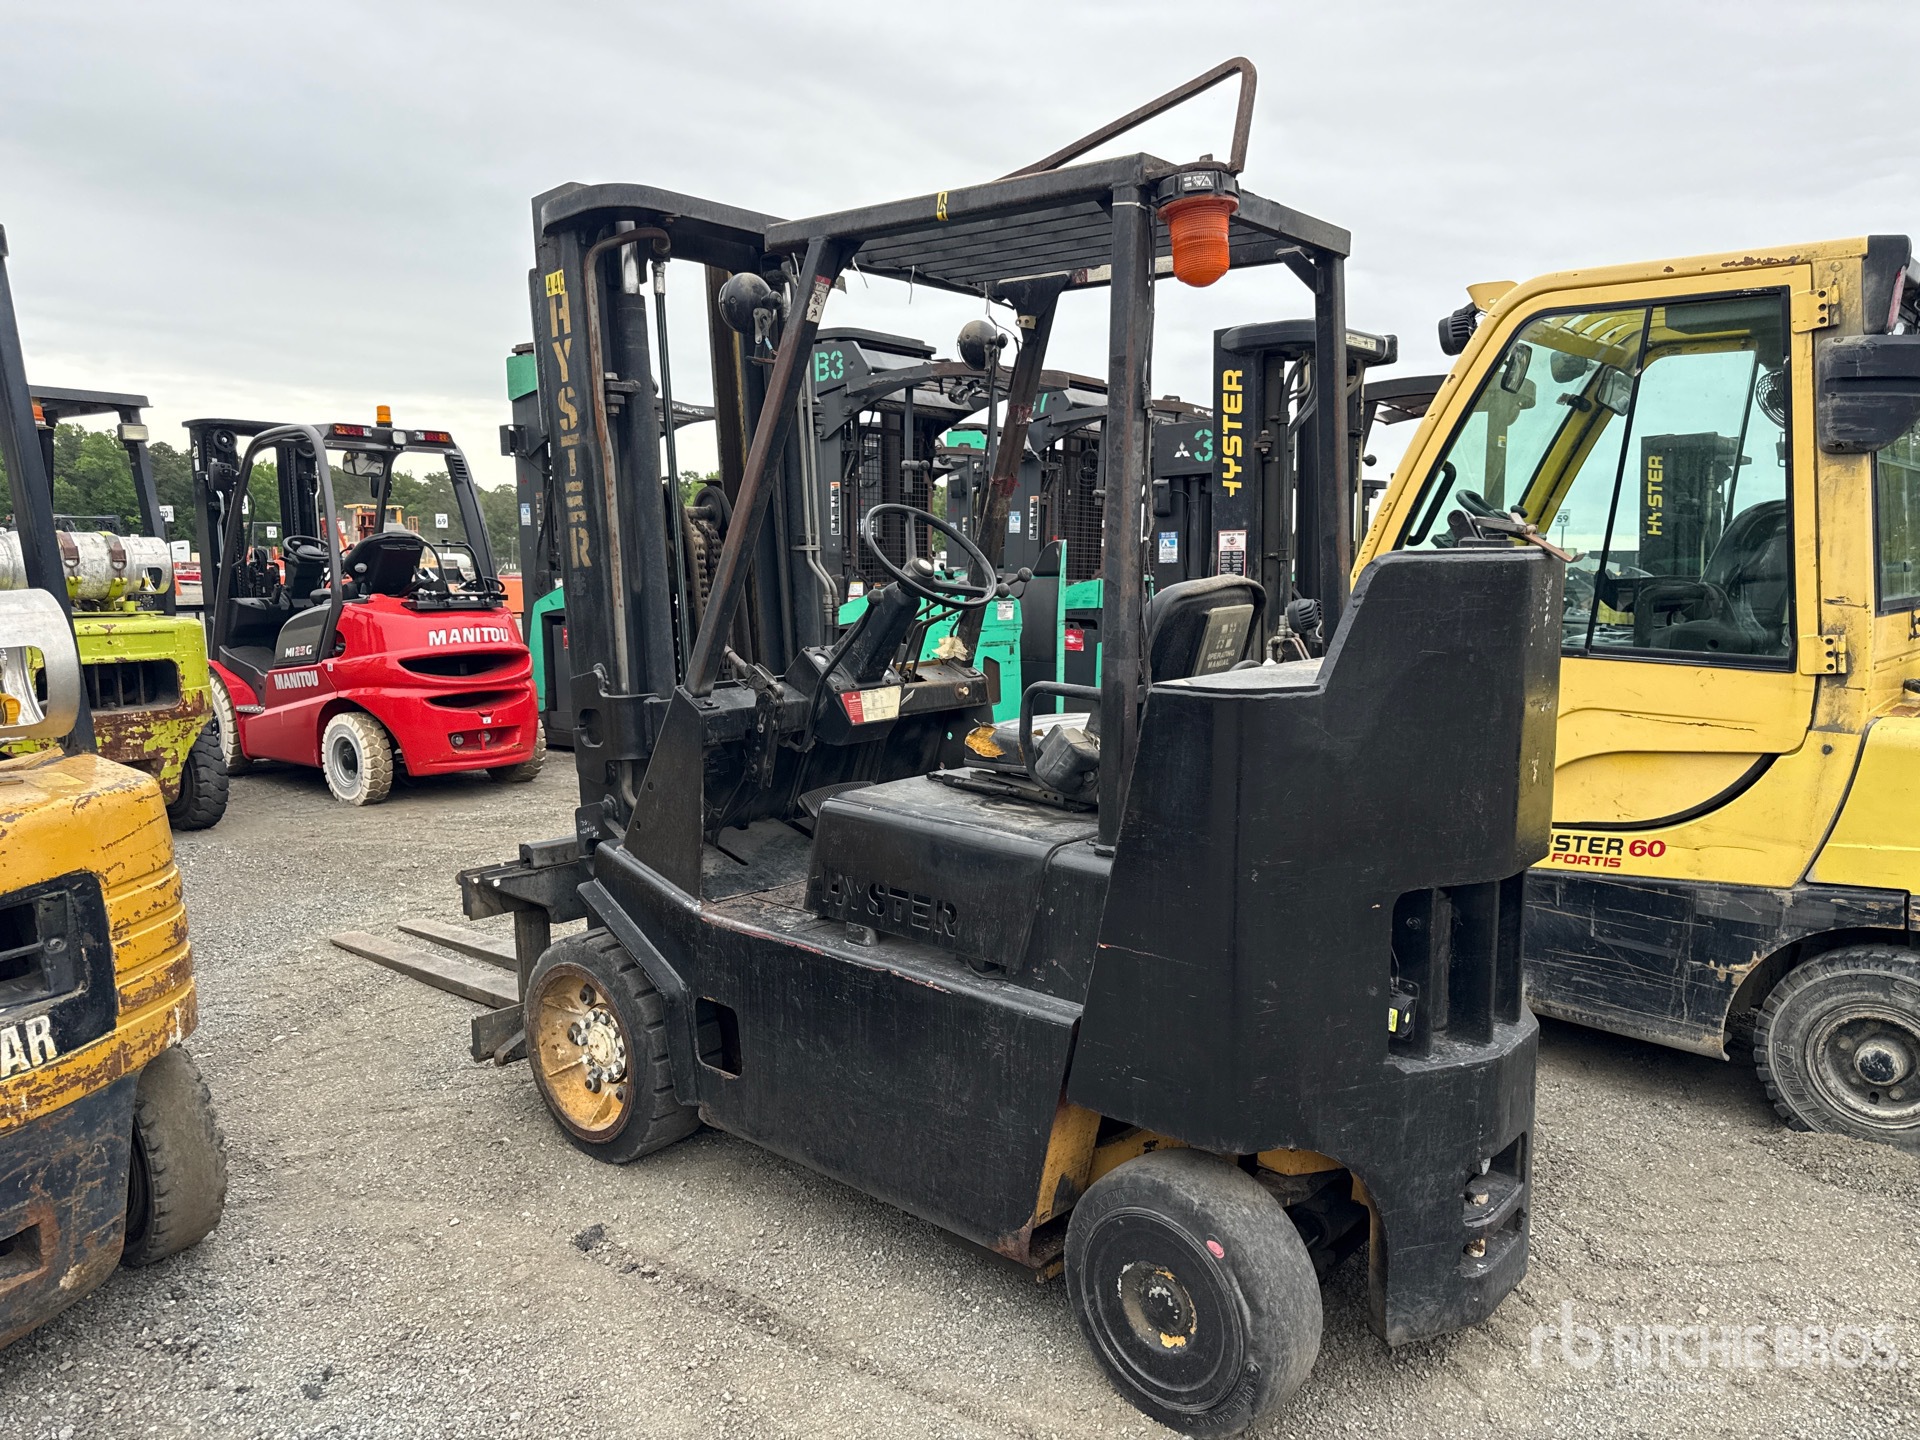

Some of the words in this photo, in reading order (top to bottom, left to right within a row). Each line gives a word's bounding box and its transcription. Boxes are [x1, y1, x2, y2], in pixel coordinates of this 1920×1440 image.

[815, 351, 844, 382] B3
[549, 290, 592, 568] HYSTER
[1223, 369, 1243, 498] HYSTER
[1194, 428, 1213, 462] 3
[1647, 455, 1663, 536] HYSTER
[437, 518, 447, 526] 69
[1556, 514, 1569, 523] 59
[428, 627, 508, 646] MANITOU
[274, 670, 319, 690] MANITOU
[1551, 833, 1624, 855] STER
[1629, 839, 1666, 858] 60
[1551, 853, 1622, 868] FORTIS
[822, 869, 958, 938] HYSTER
